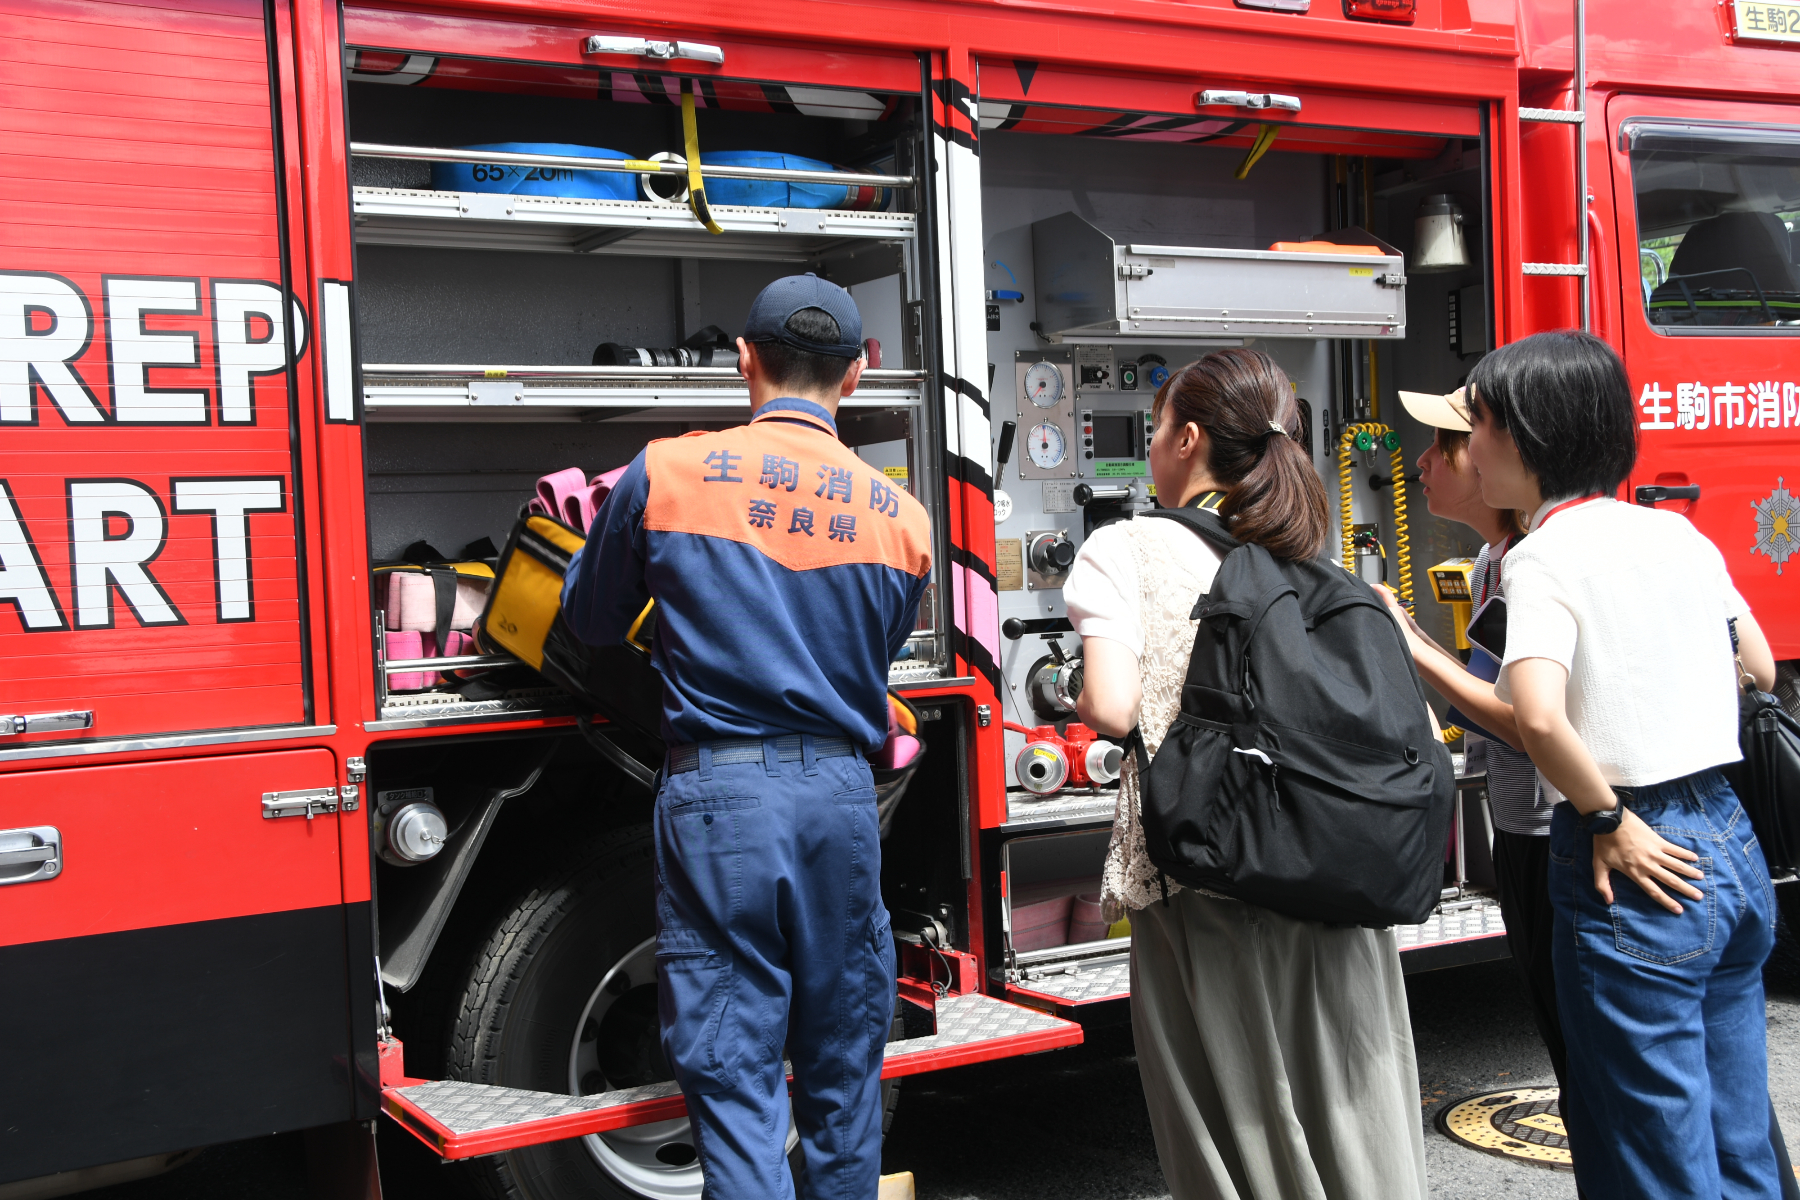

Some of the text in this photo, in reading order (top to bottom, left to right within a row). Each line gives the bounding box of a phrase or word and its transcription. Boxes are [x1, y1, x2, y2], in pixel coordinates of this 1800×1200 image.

[703, 449, 899, 518] 生駒消防
[747, 498, 857, 543] 奈良県
